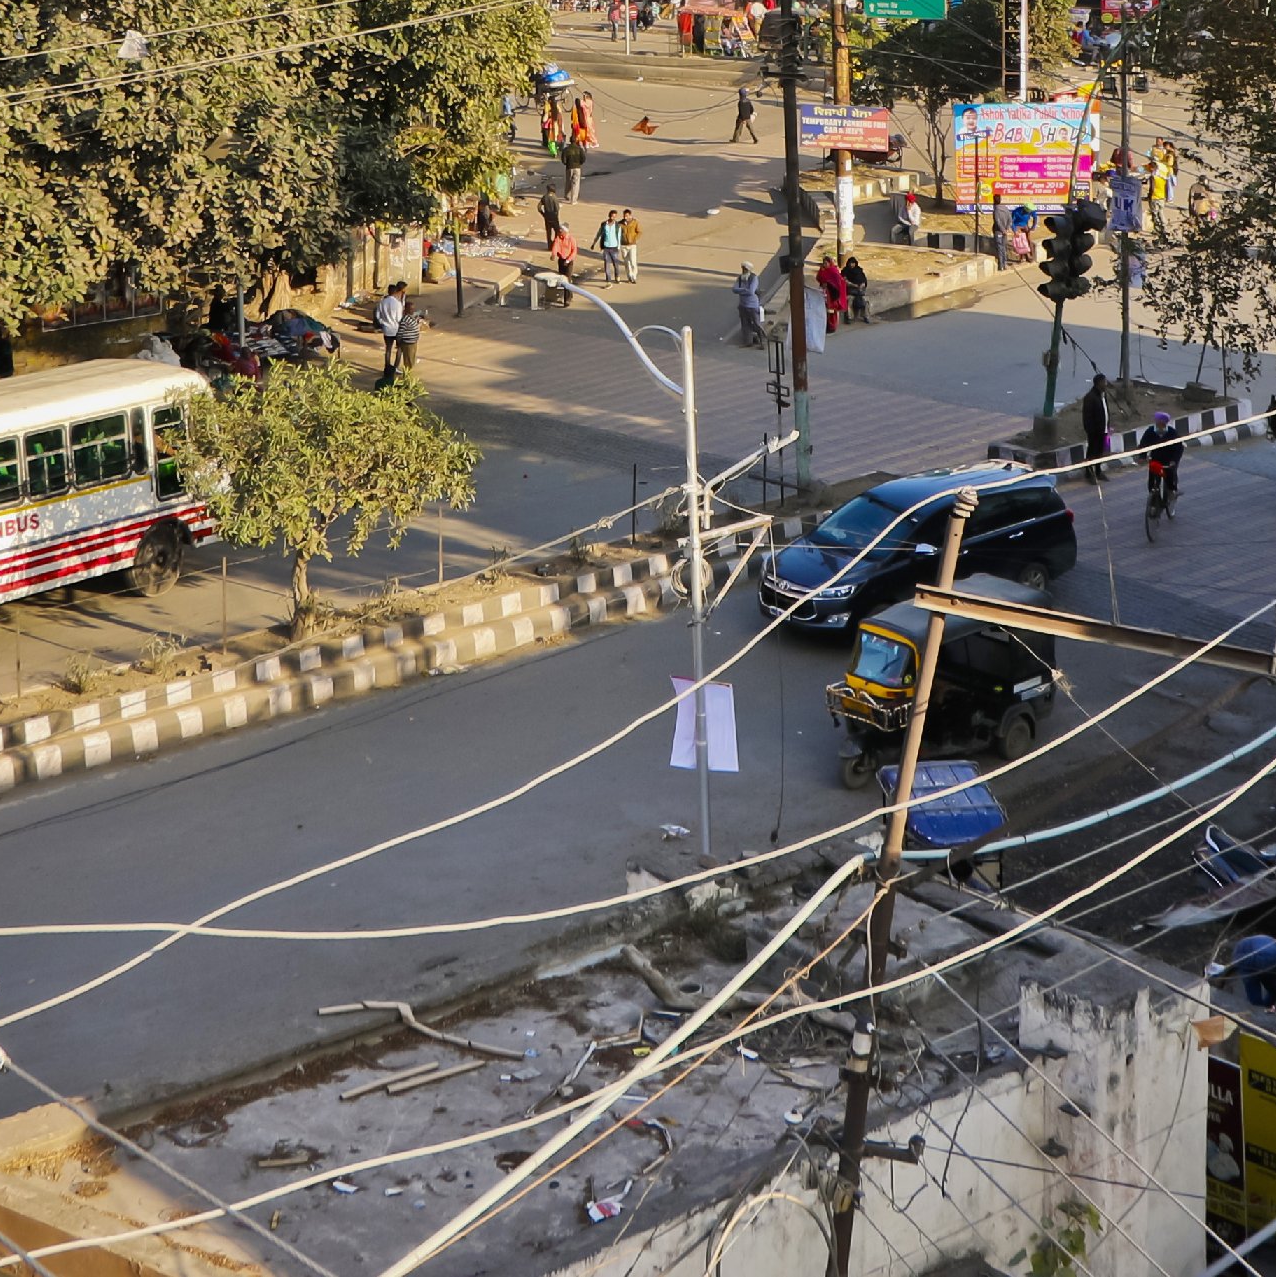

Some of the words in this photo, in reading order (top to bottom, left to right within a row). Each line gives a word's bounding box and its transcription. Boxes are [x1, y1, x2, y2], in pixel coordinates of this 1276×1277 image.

[980, 107, 1004, 120] Ashok
[1034, 107, 1057, 120] Public
[1061, 107, 1087, 120] Schoo
[802, 117, 842, 127] TEMPORARY
[990, 122, 1036, 145] BABY
